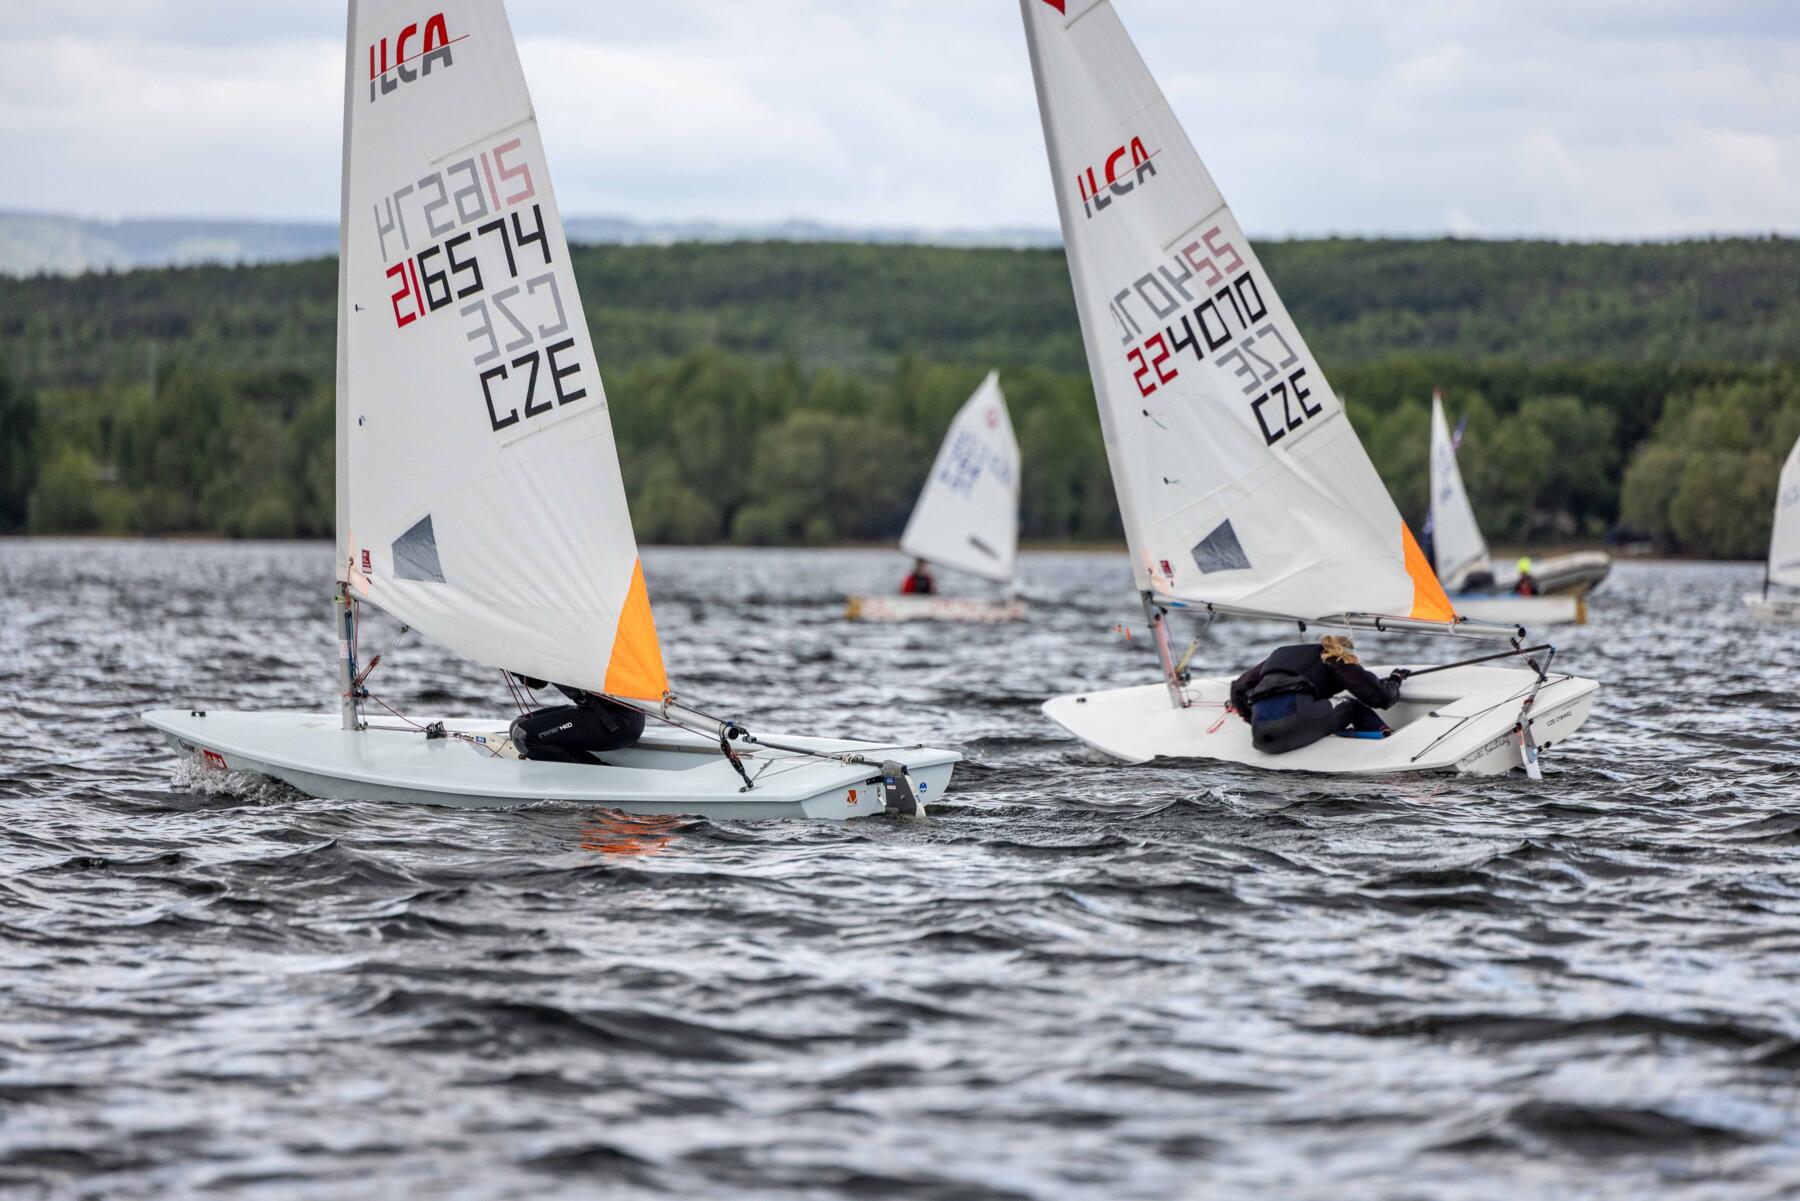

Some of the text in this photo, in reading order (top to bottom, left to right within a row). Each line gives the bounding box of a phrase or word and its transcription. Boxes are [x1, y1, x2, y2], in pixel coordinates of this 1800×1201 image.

[370, 12, 454, 103] ILCA
[1077, 136, 1158, 219] ILCA
[386, 203, 553, 329] 216574
[1127, 270, 1269, 398] 224070
[479, 337, 588, 432] CZE
[1250, 367, 1323, 447] CZE
